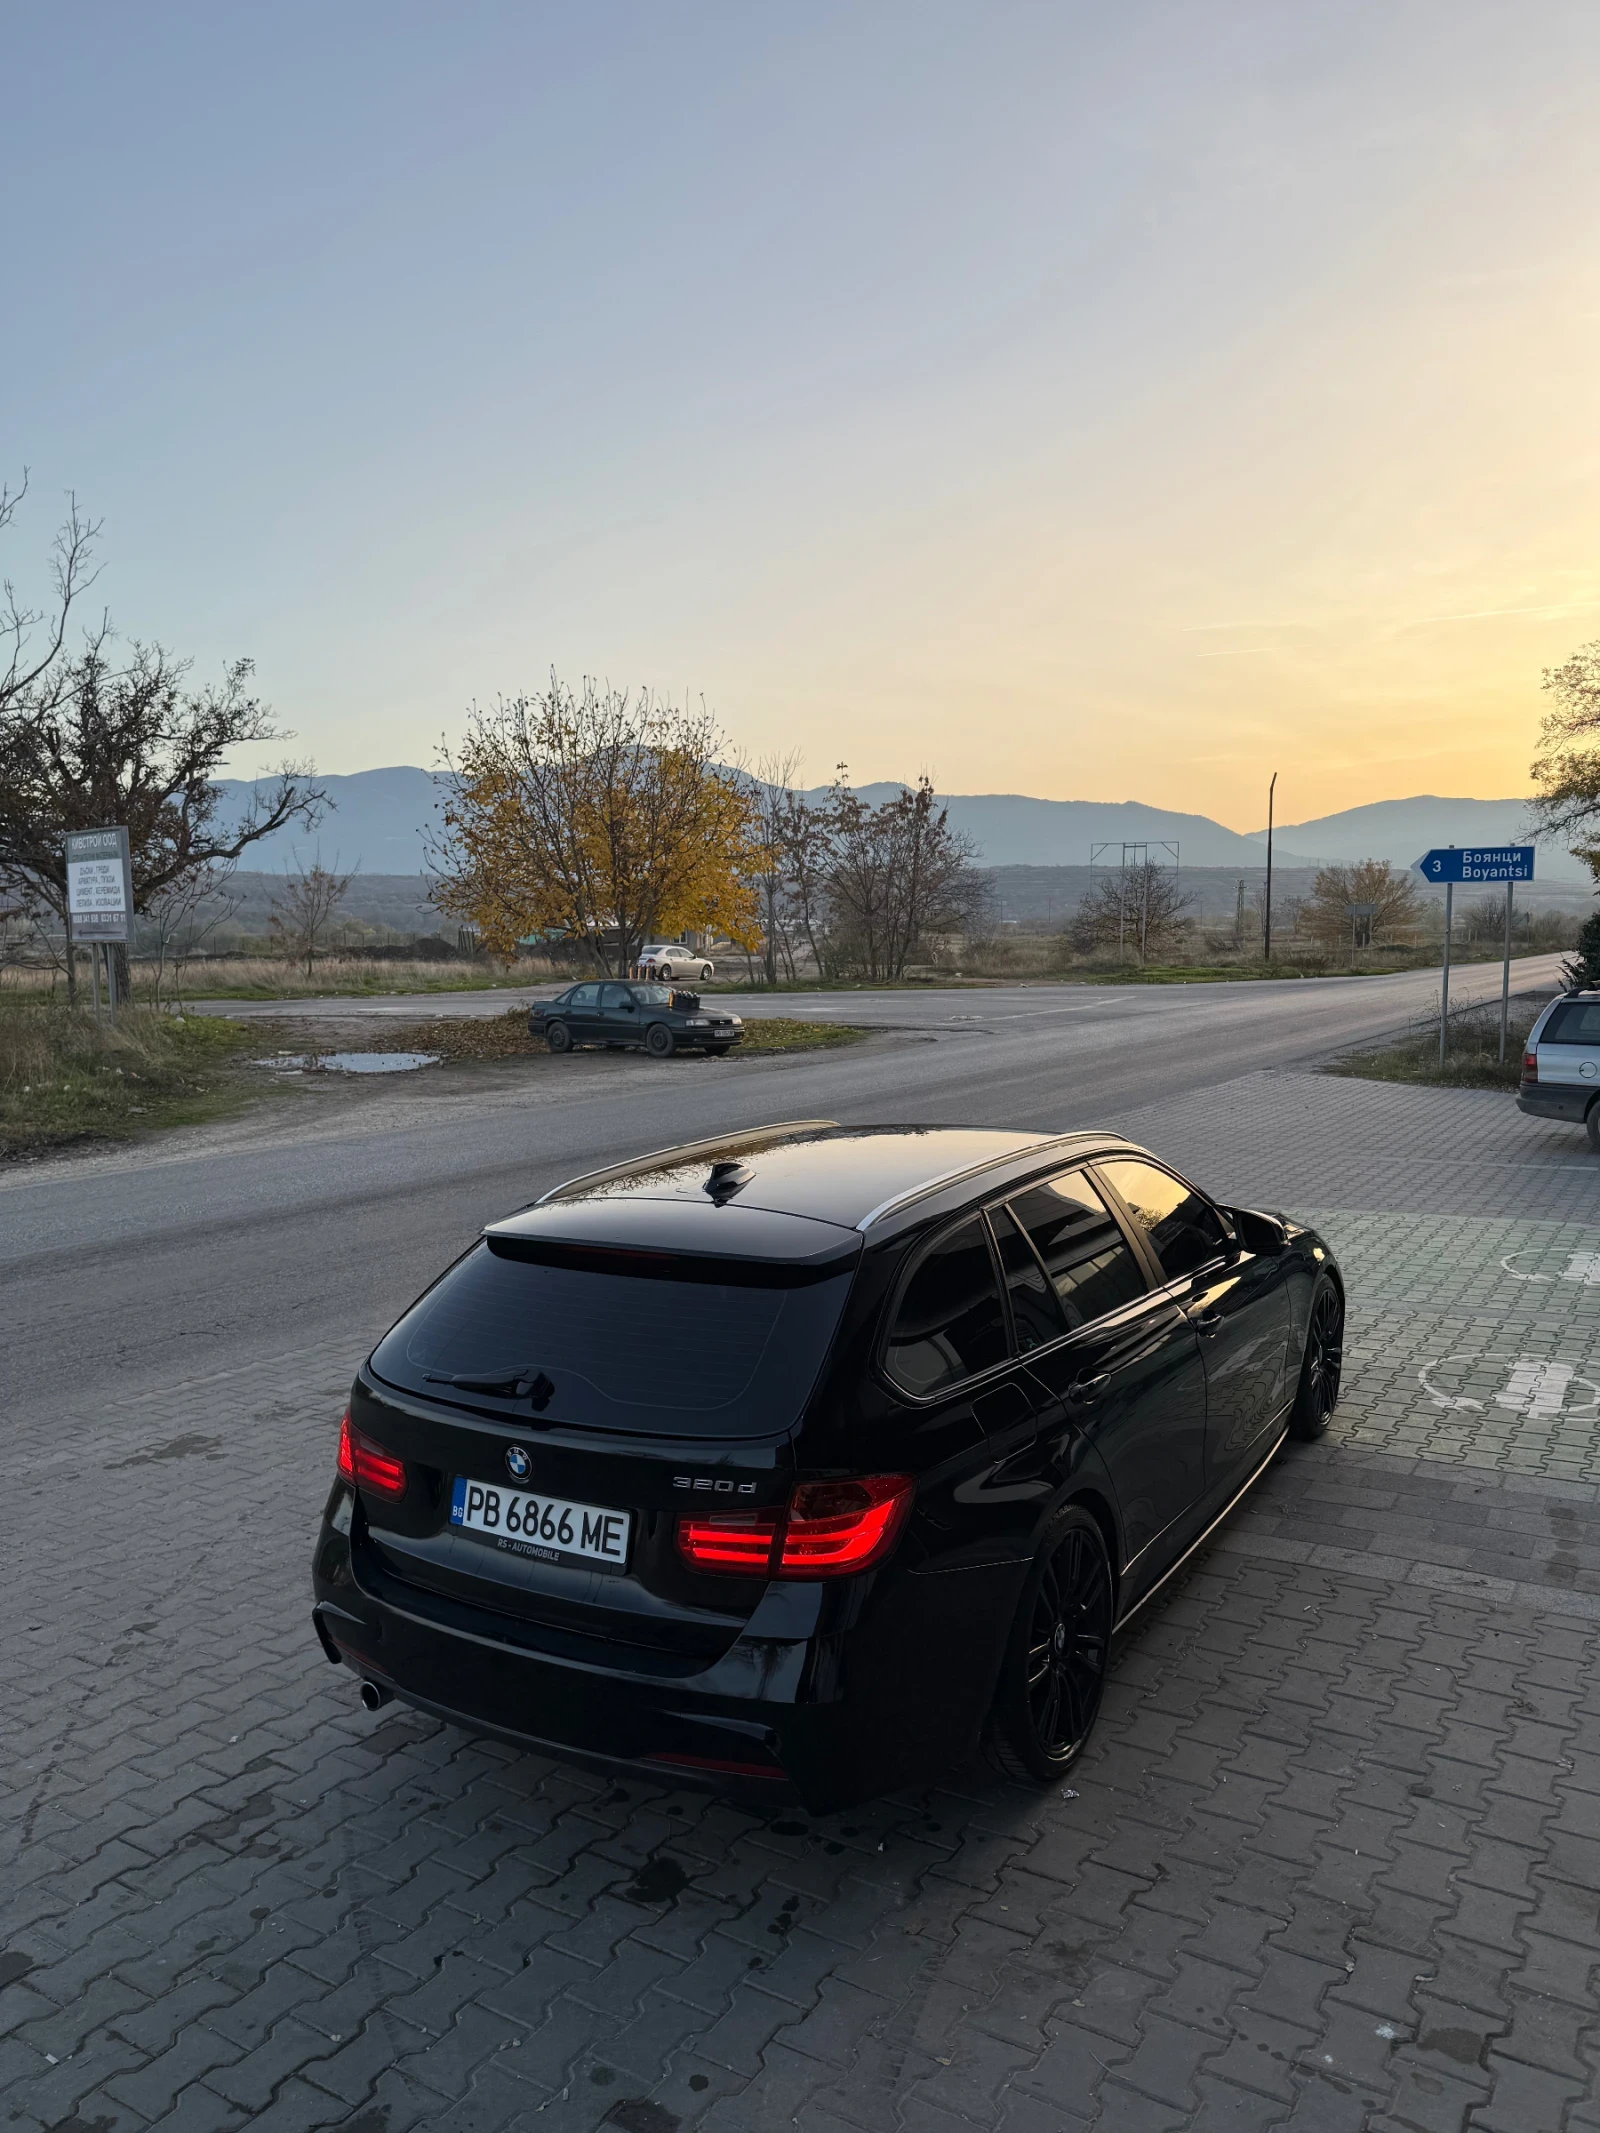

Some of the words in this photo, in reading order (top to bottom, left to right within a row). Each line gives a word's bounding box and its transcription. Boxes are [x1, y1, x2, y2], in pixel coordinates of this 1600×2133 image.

[102, 833, 117, 847] ООД
[1462, 851, 1521, 863] Боянци
[1432, 860, 1441, 872] 3
[1462, 865, 1528, 880] Boyantsi
[452, 1505, 464, 1518] BG
[466, 1485, 500, 1528] PB
[506, 1496, 574, 1545] 6866
[580, 1511, 625, 1556] ME
[511, 1541, 560, 1562] AUTOMOBILE
